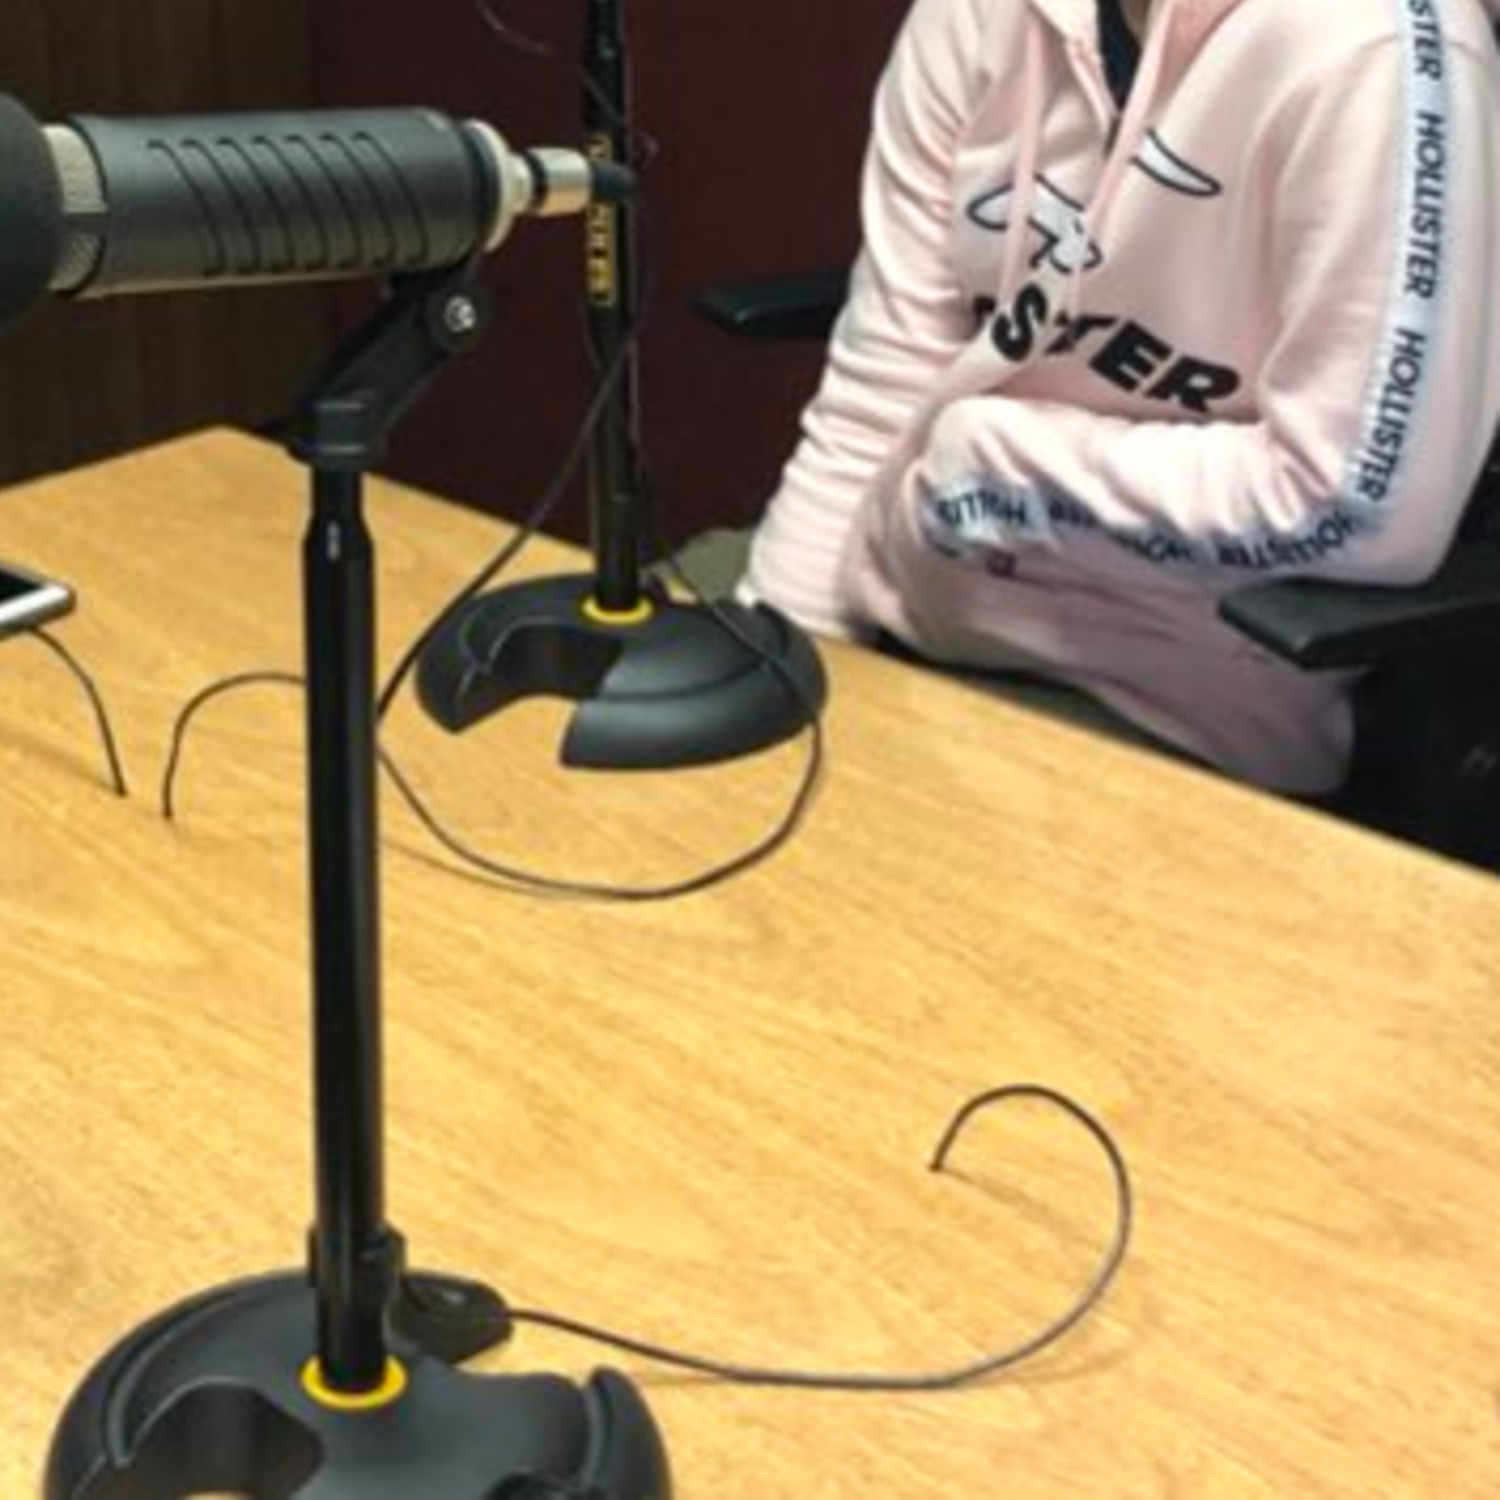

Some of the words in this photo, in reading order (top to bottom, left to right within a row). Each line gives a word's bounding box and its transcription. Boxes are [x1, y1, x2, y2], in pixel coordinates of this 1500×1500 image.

[1403, 110, 1445, 301] HOLLISTER
[972, 282, 1240, 413] STER
[1355, 326, 1427, 502] HOLLISTER
